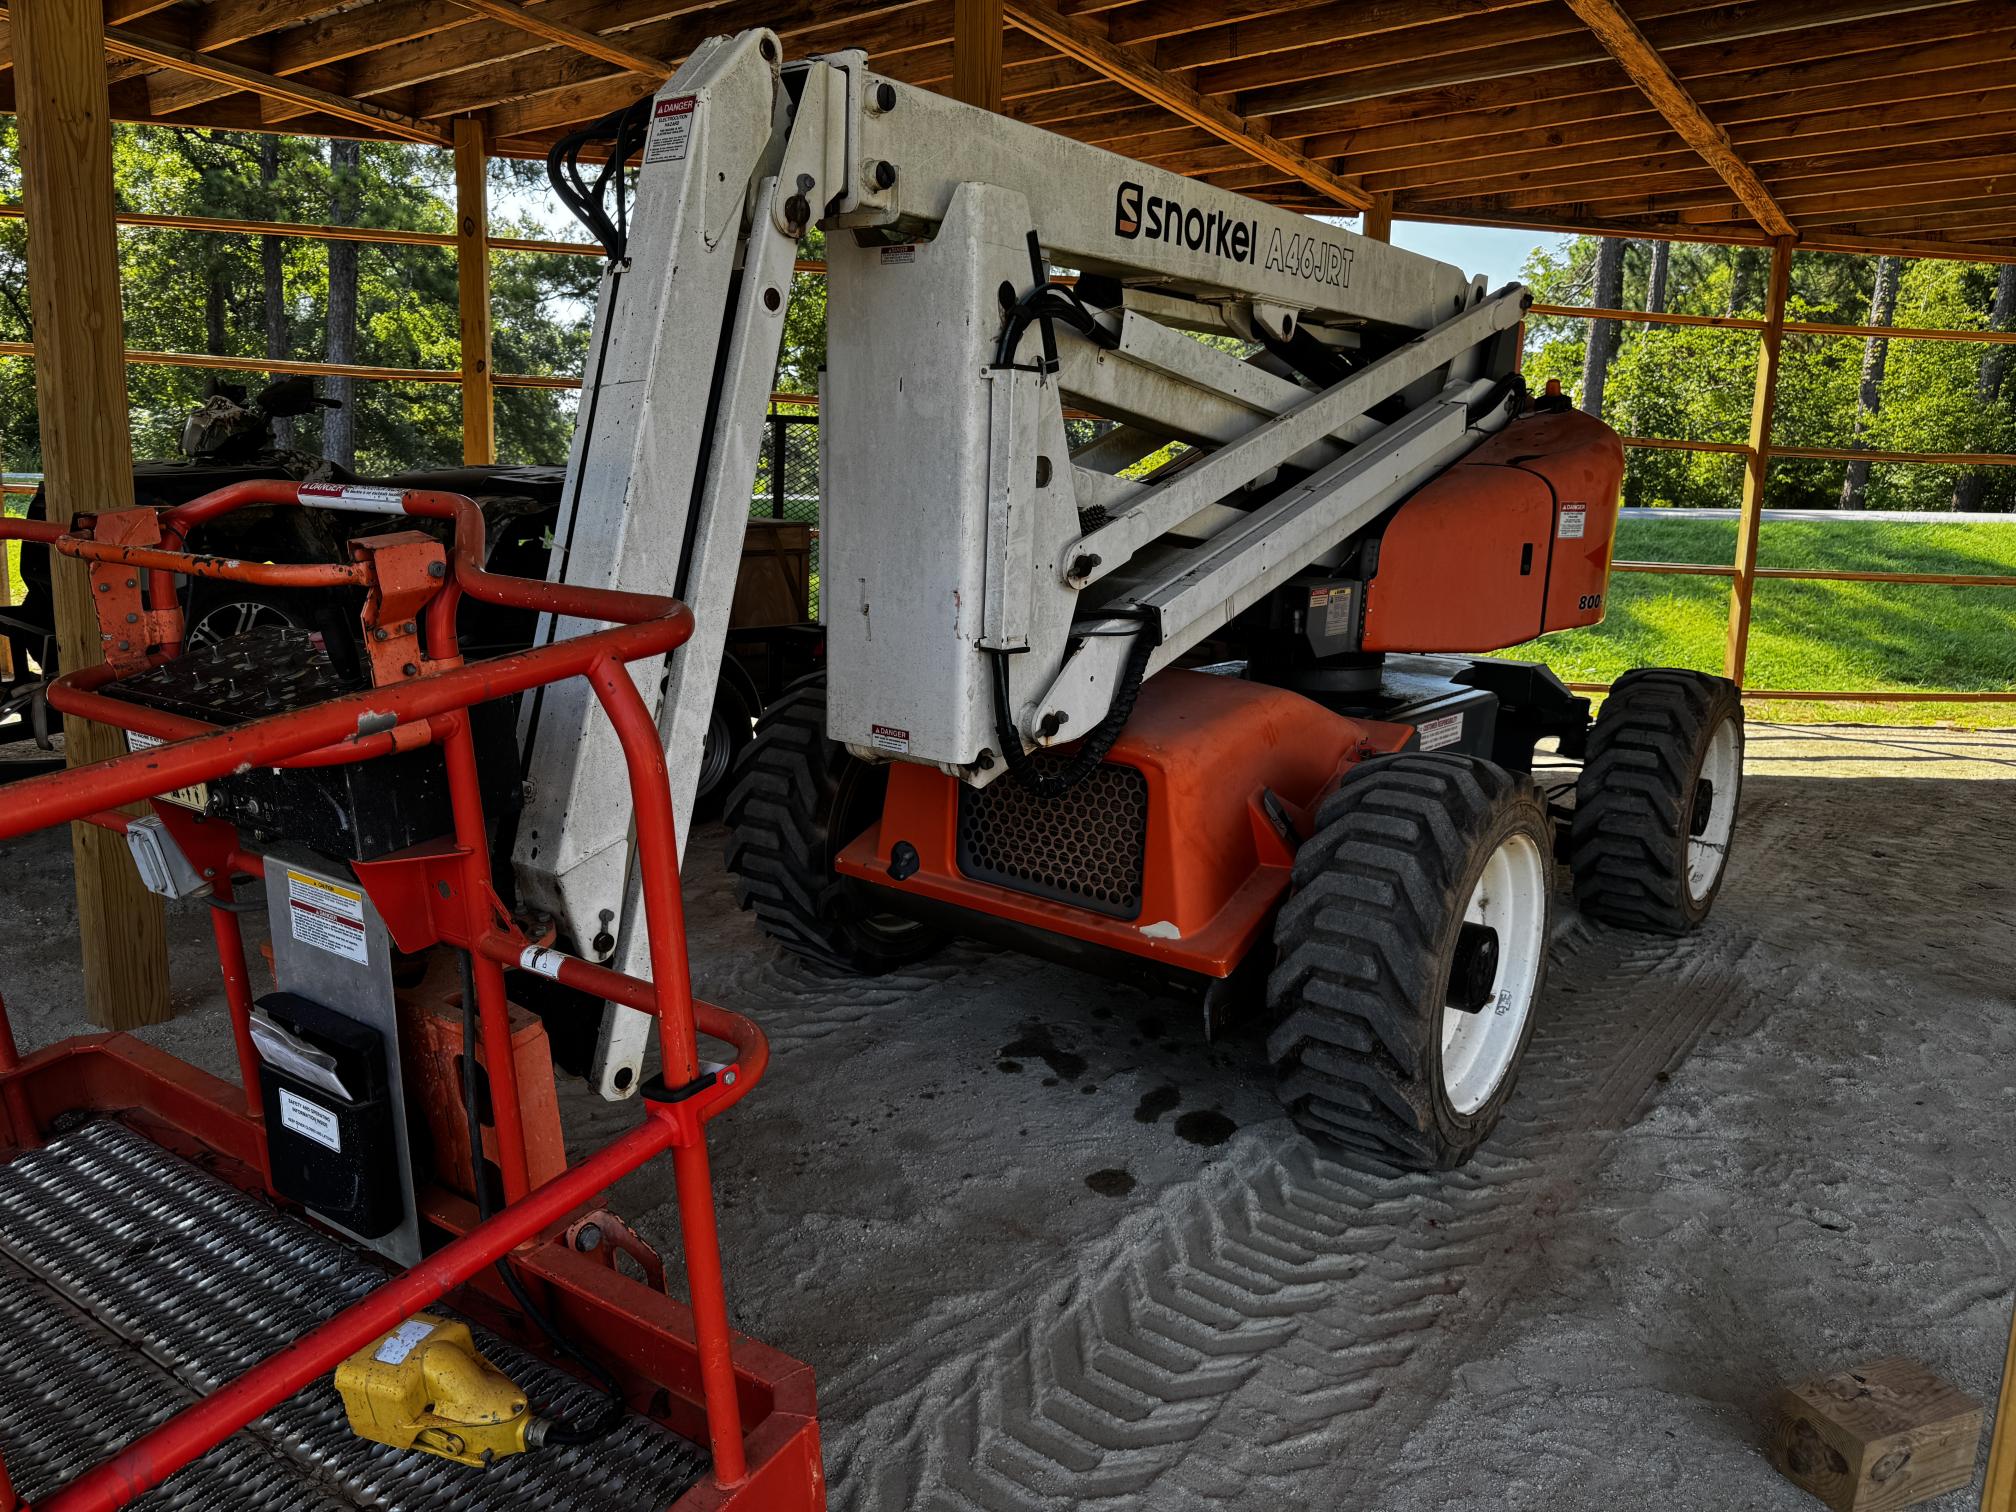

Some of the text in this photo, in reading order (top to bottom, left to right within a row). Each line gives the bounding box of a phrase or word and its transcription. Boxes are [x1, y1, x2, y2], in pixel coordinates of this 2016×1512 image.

[664, 100, 693, 112] DANGER
[1145, 196, 1257, 265] snorkel
[1265, 228, 1353, 288] A46JRT
[309, 482, 344, 492] DANGER
[880, 727, 906, 738] DANGER
